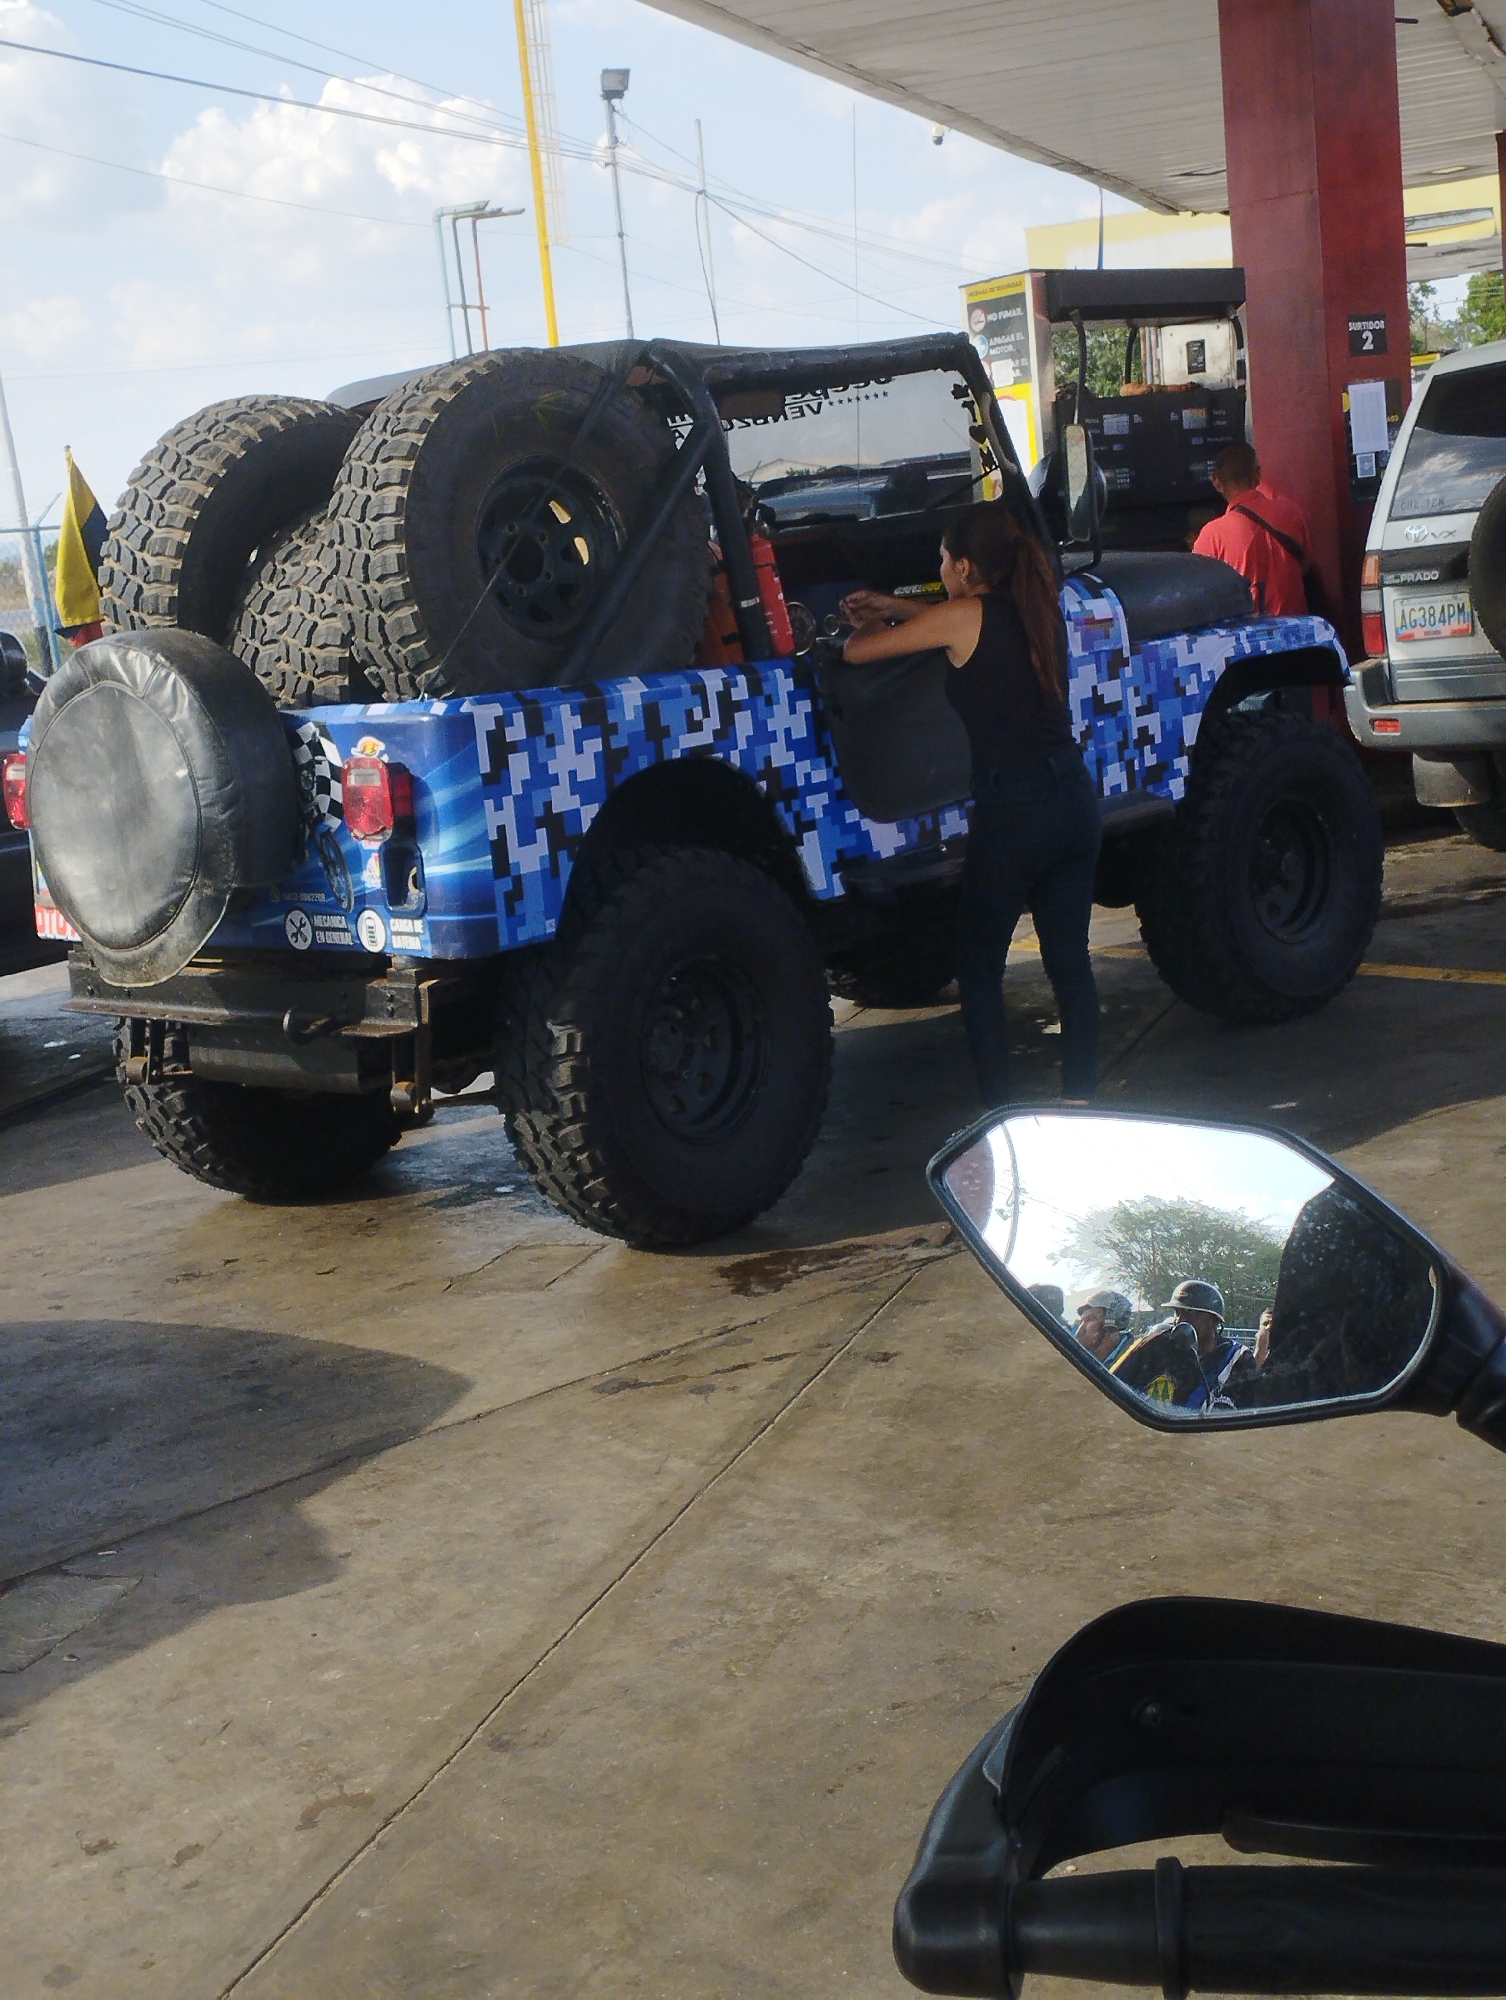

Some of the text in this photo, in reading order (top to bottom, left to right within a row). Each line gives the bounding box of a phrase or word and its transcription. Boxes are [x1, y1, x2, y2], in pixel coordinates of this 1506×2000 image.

[987, 312, 998, 323] NO
[1349, 320, 1385, 332] SURTIDOR
[989, 333, 1015, 346] APAGAR
[1361, 331, 1374, 350] 2
[1400, 570, 1440, 582] PRADO
[1400, 602, 1466, 631] AG384PM
